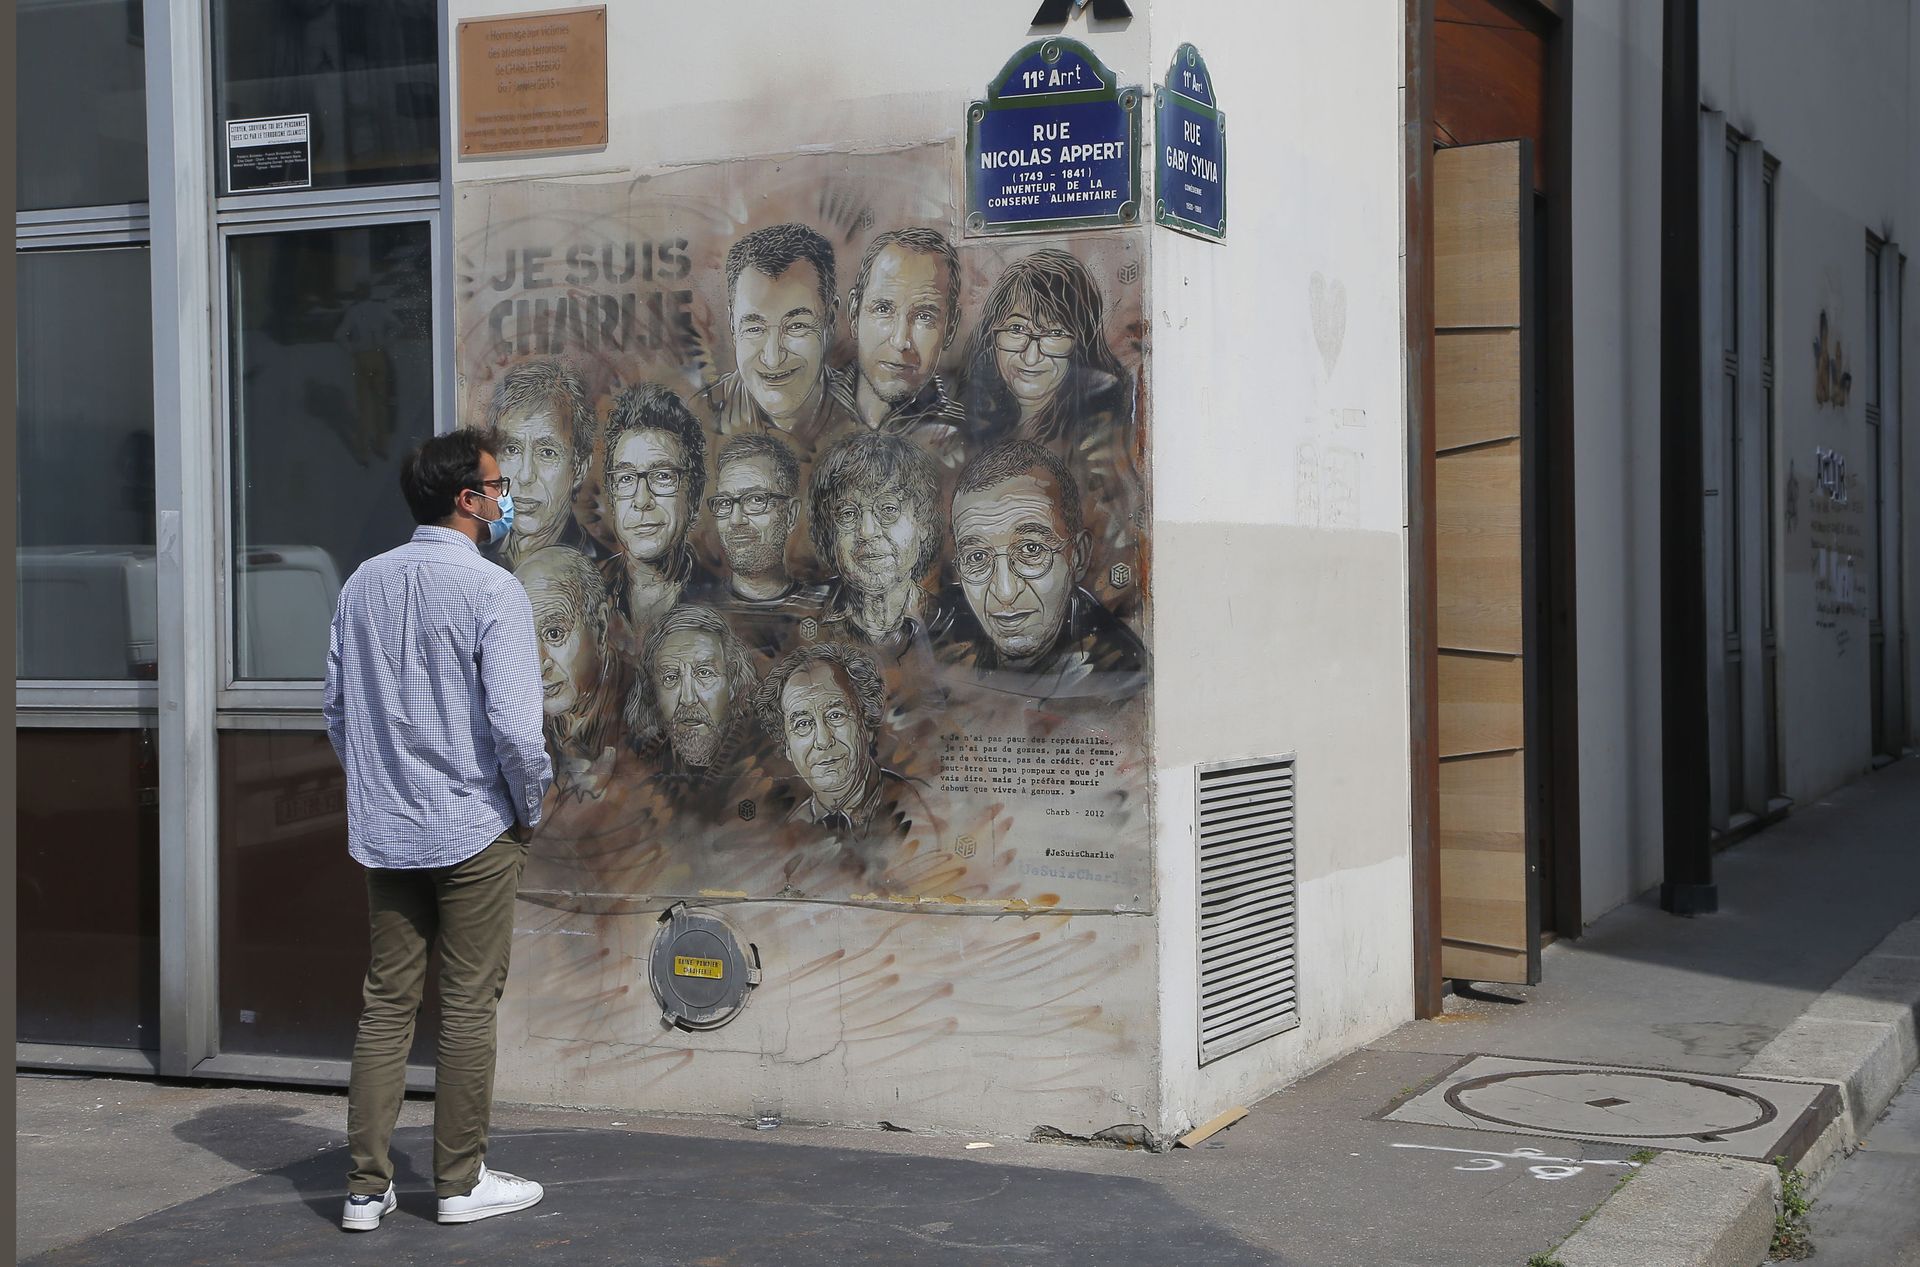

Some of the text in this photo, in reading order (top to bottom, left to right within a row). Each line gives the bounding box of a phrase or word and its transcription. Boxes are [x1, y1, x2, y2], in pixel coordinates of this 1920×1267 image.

[1022, 70, 1044, 88] 11e
[1033, 122, 1070, 142] RUE
[1184, 120, 1201, 146] RUE
[981, 142, 1124, 169] NICOLAS APPERT
[1166, 145, 1218, 184] GABY SYLVIA
[1002, 179, 1102, 195] INVENTEUR DE LA
[988, 190, 1117, 208] CONSERVE ALIMENTAIRE
[490, 238, 692, 292] JE SUIS
[488, 290, 693, 355] CHARLIE
[945, 744, 954, 752] je
[1051, 737, 1113, 745] représailles,
[1095, 769, 1104, 777] je
[1045, 848, 1115, 859] #JeSuisCharlie
